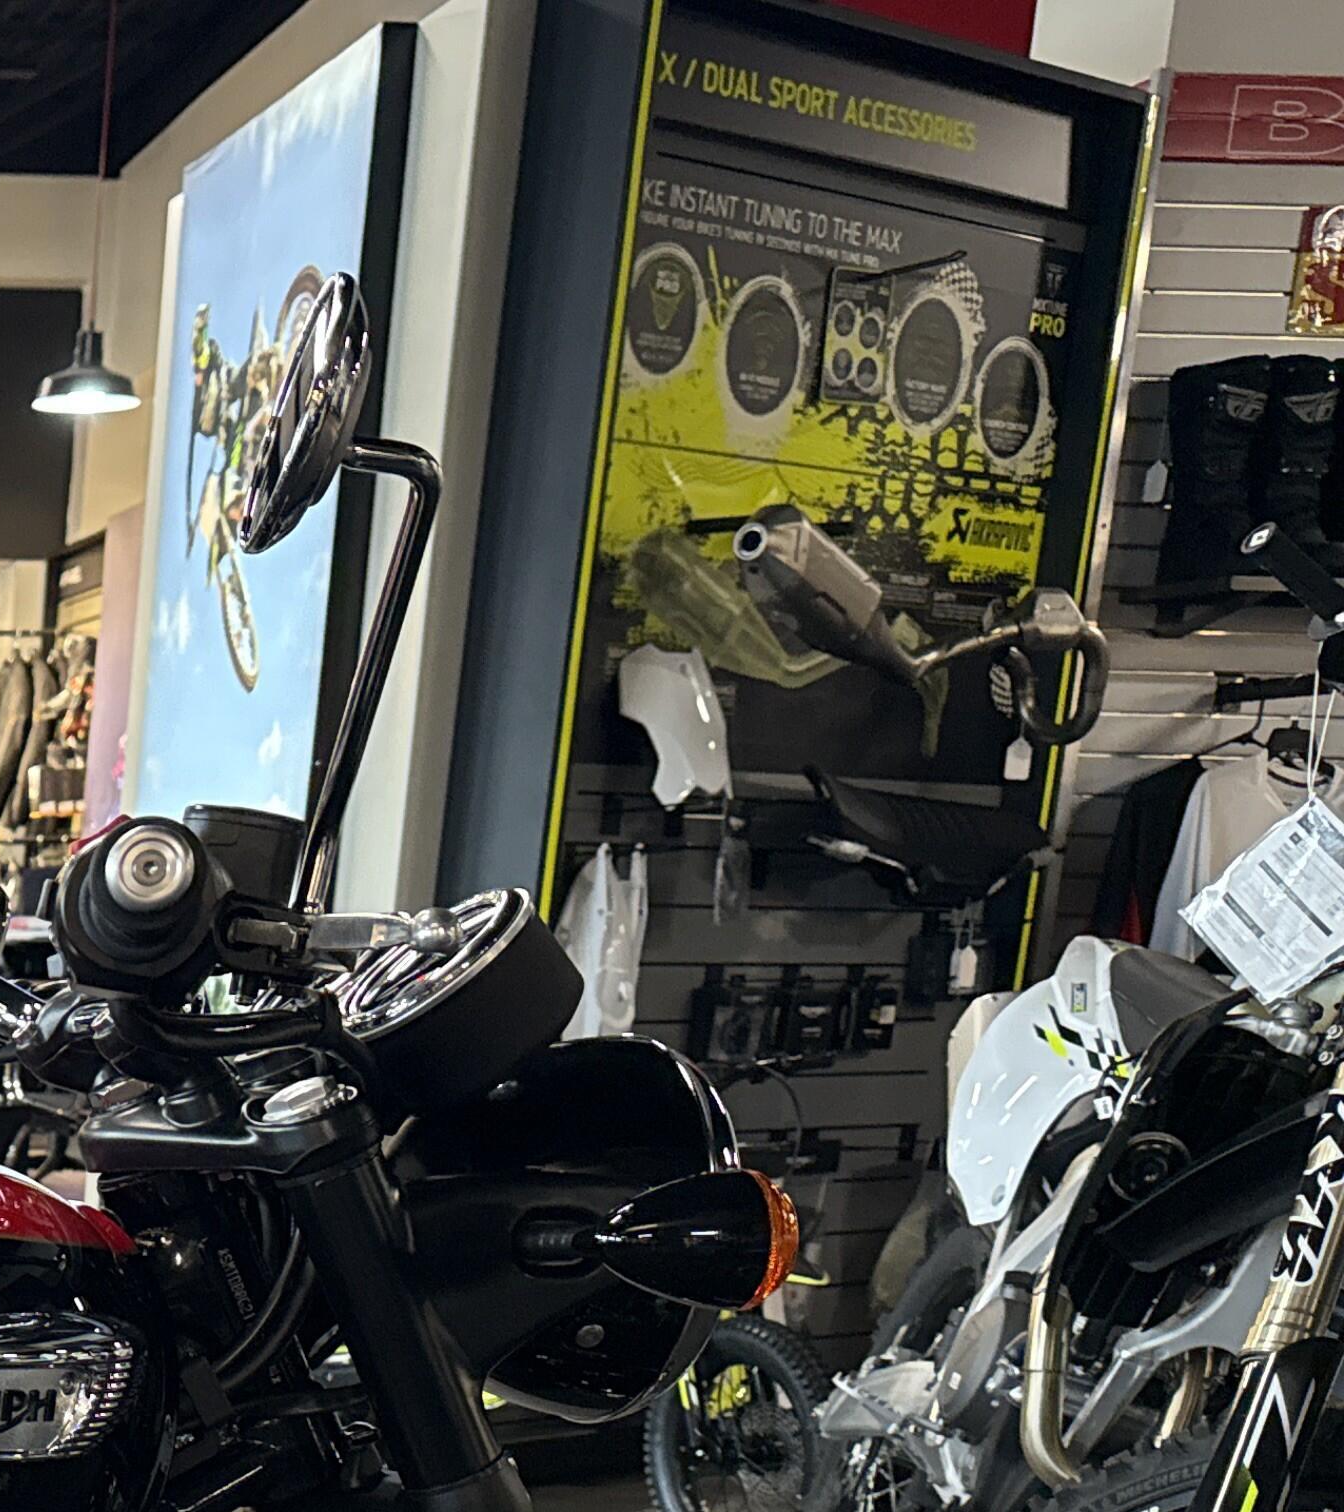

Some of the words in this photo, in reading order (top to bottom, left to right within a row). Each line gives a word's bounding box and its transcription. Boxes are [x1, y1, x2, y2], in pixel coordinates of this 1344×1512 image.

[702, 62, 763, 104] DUAL
[768, 77, 839, 119] SPORT
[842, 96, 977, 151] ACCESSORIES
[669, 185, 741, 222] INSTANT
[744, 199, 803, 232] TUNING
[807, 209, 828, 238] TO
[833, 216, 863, 245] THE
[865, 226, 903, 254] MAX
[1029, 313, 1067, 338] PRO
